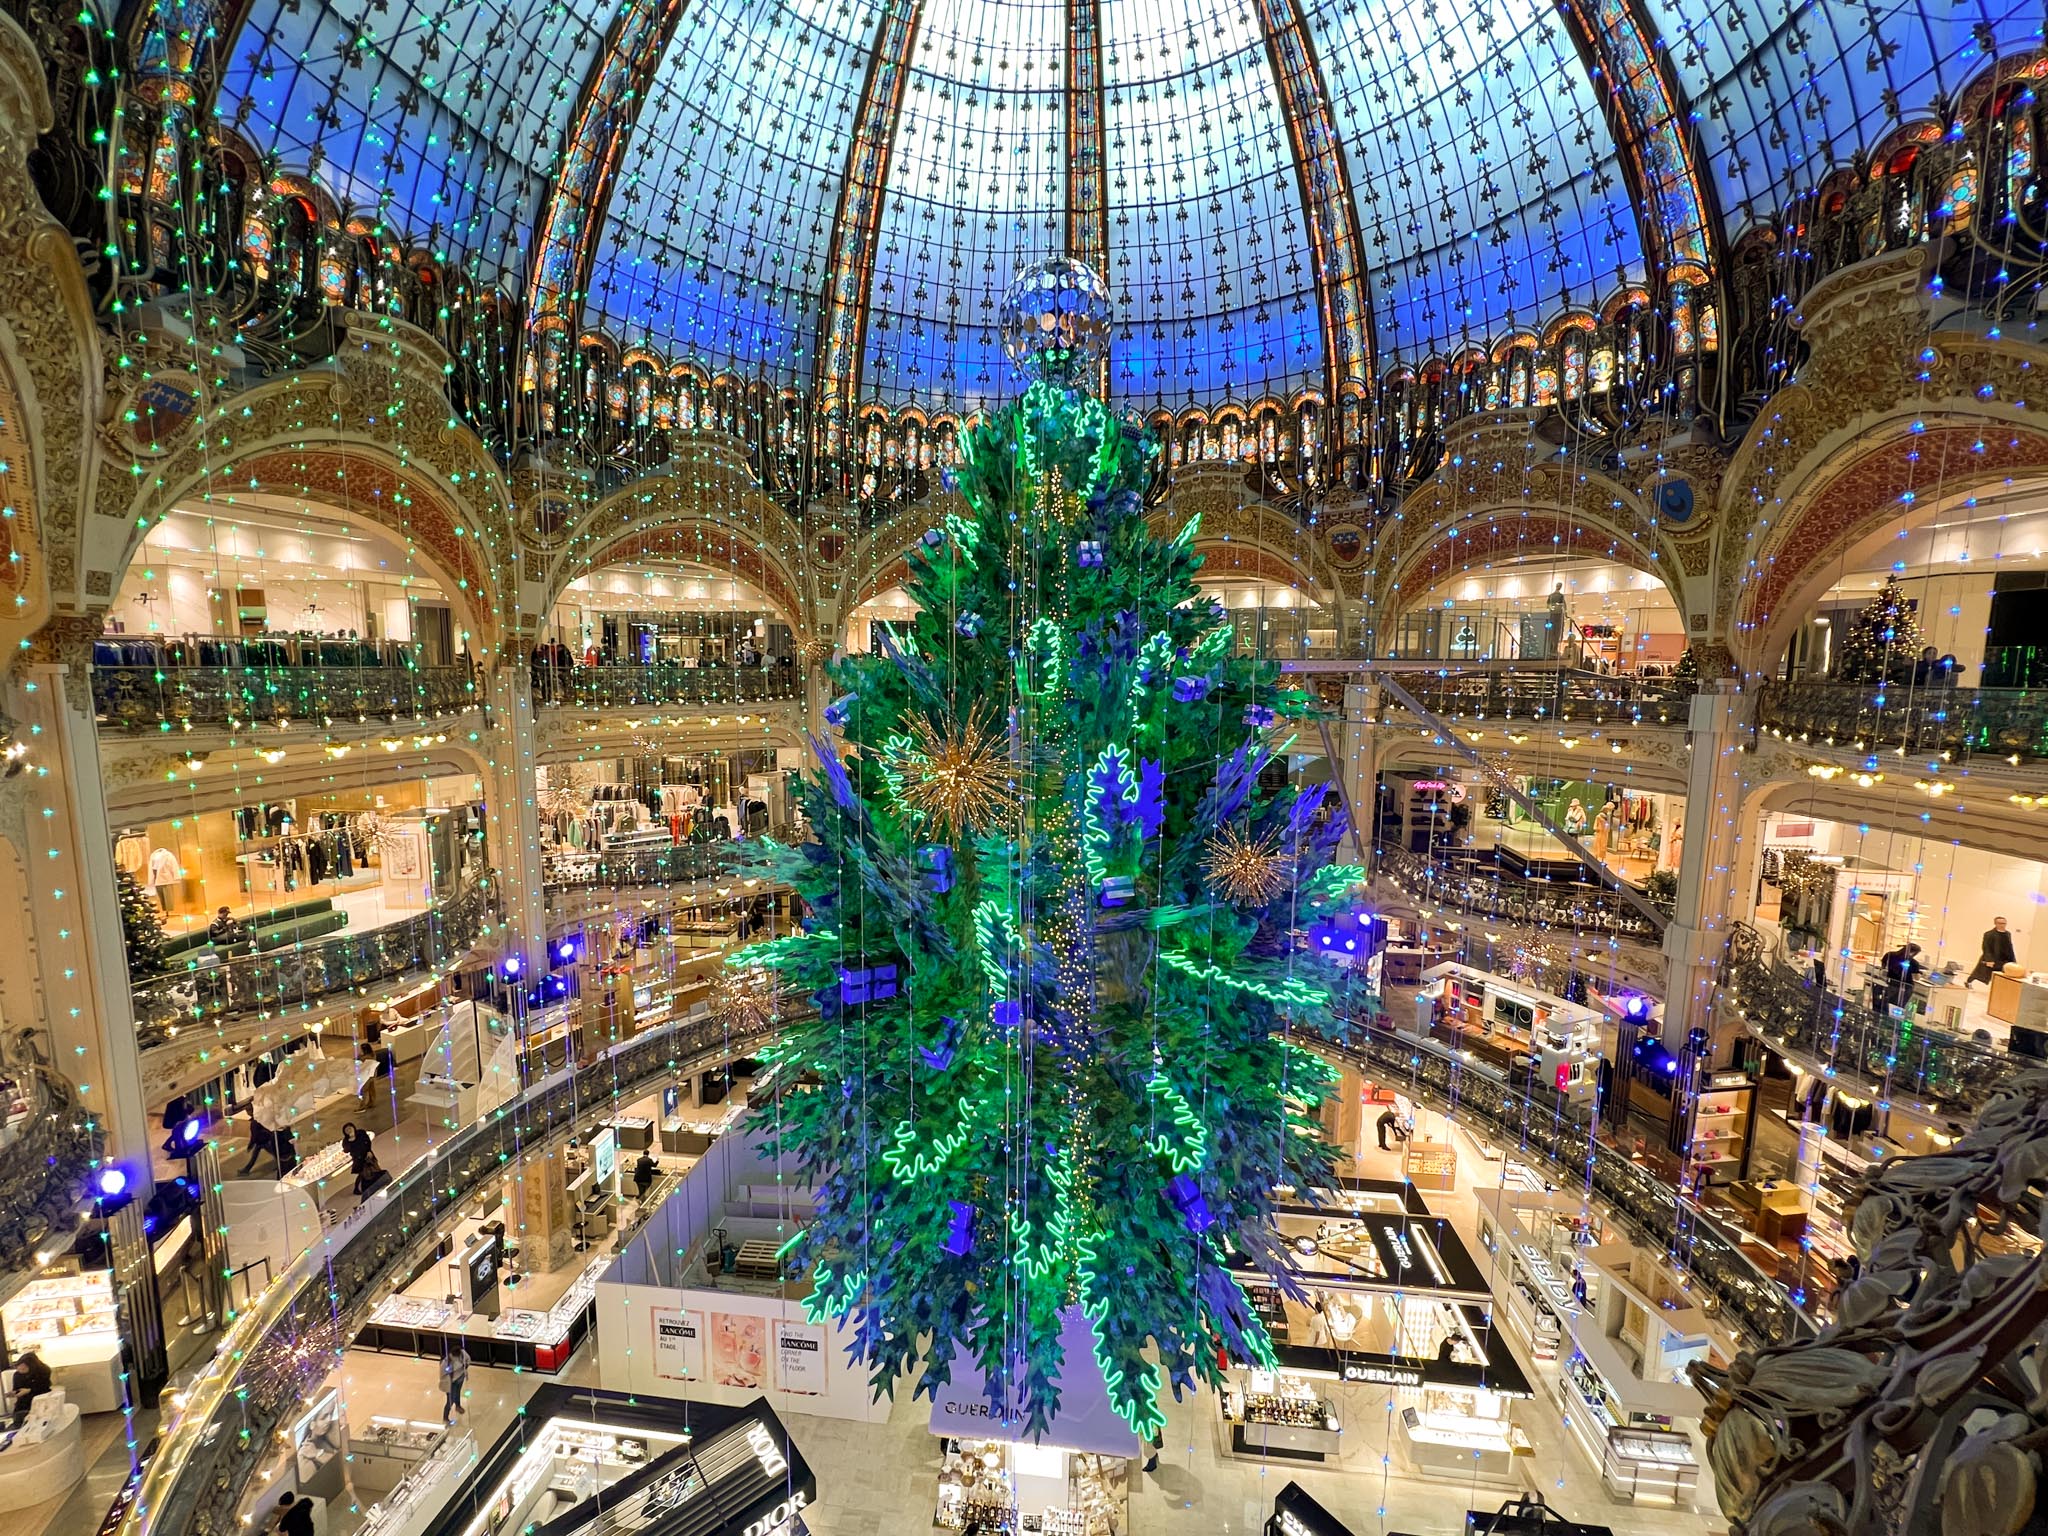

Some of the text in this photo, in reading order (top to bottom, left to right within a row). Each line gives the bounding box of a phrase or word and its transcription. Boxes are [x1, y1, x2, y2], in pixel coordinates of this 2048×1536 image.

[1520, 1244, 1582, 1315] sisley
[660, 1327, 695, 1336] LANCÔME
[781, 1340, 817, 1349] LANCÔME
[1345, 1366, 1419, 1385] GUERLAIN
[747, 1422, 788, 1478] DIOR
[743, 1490, 808, 1536] DIOR
